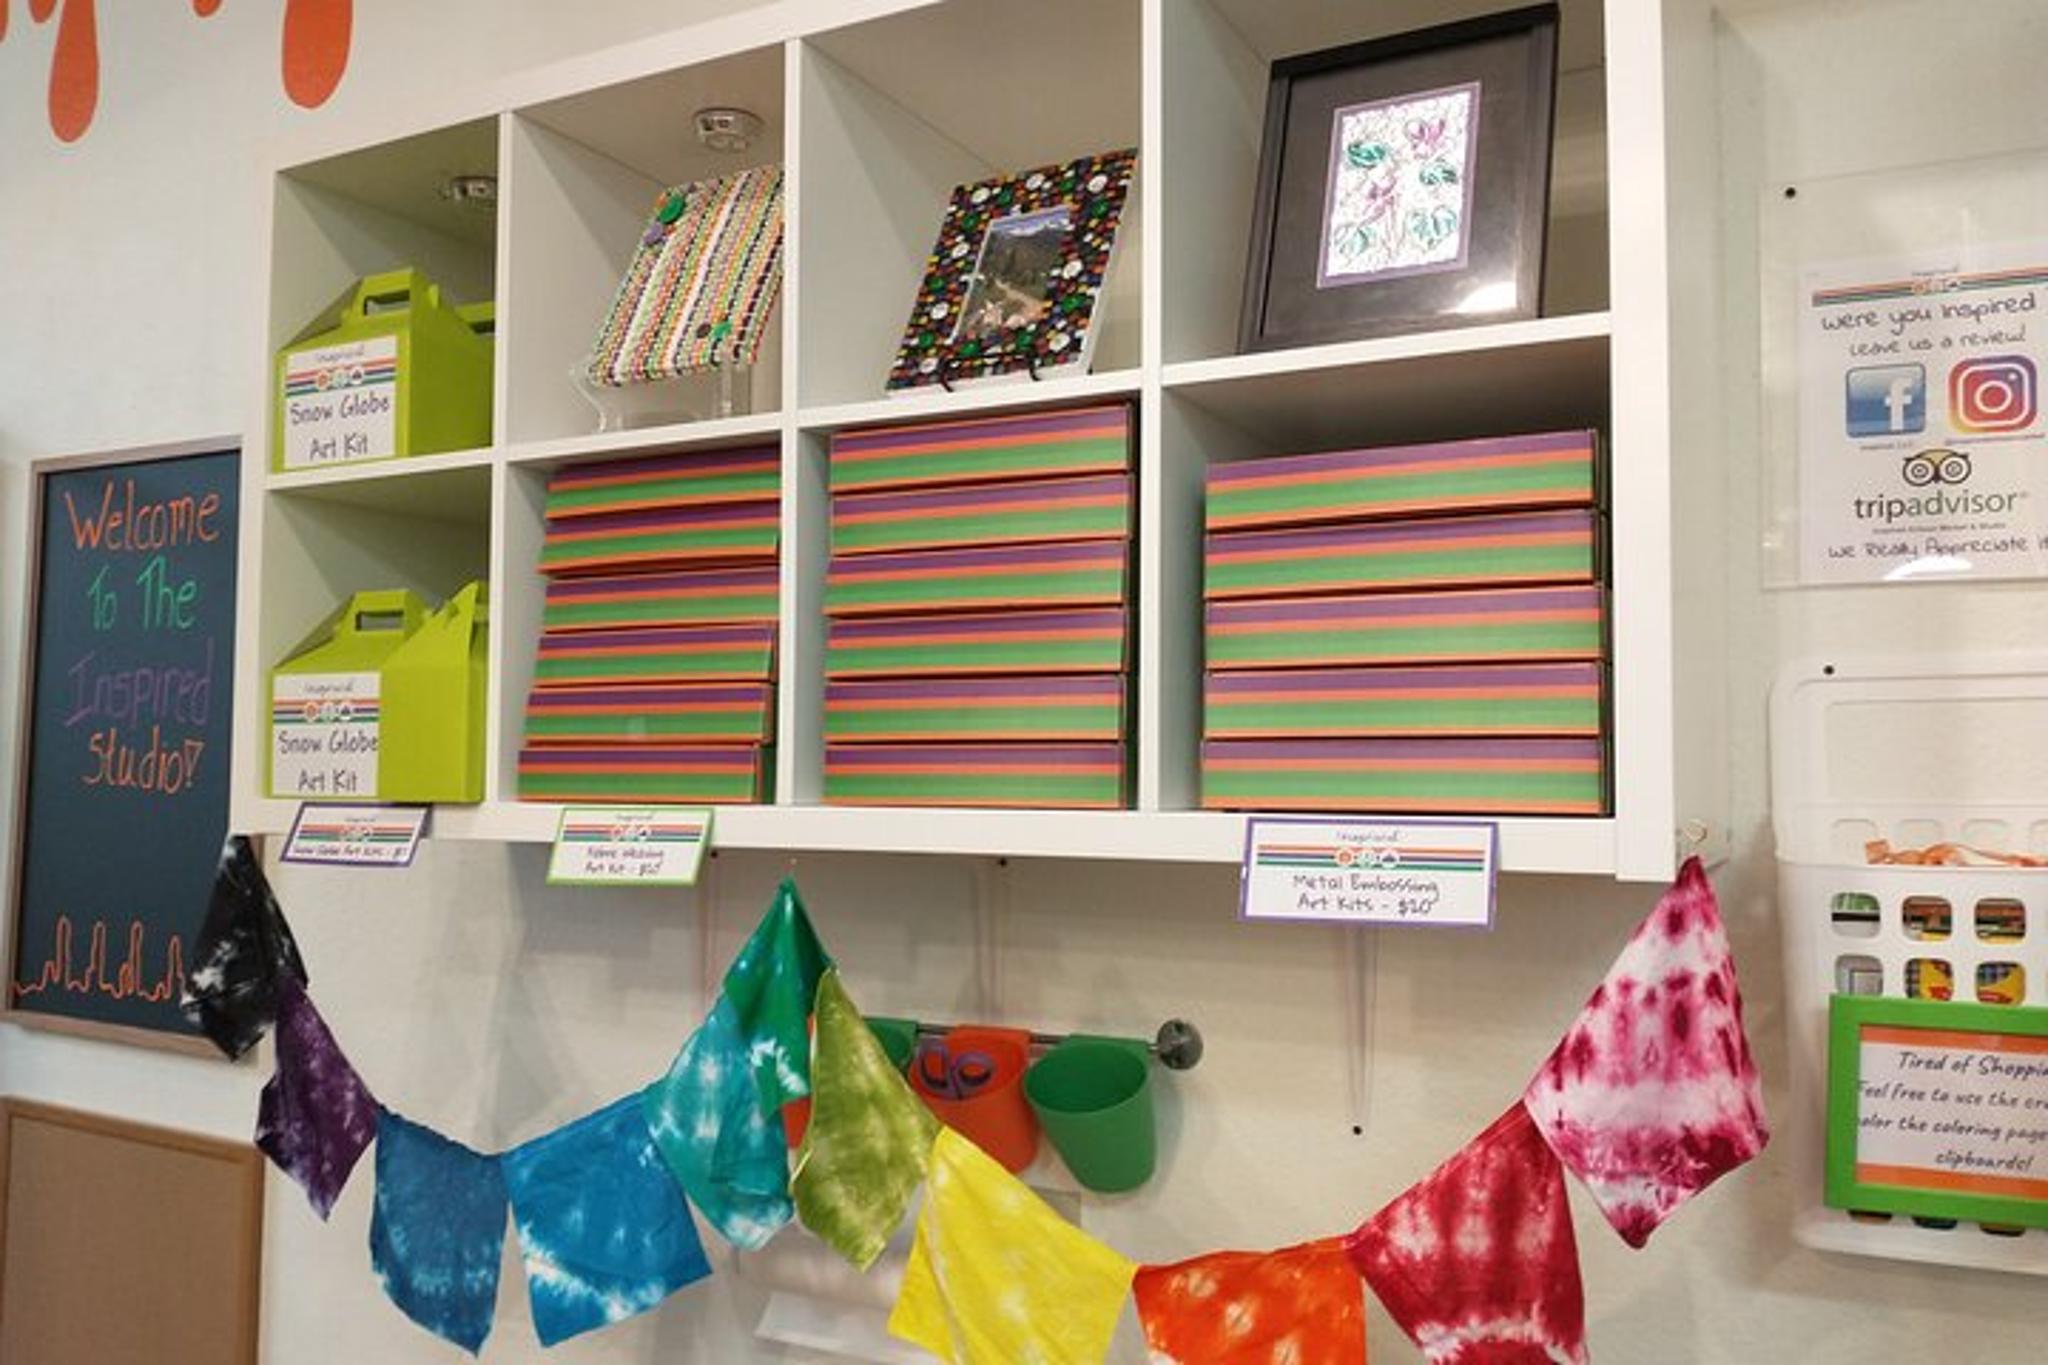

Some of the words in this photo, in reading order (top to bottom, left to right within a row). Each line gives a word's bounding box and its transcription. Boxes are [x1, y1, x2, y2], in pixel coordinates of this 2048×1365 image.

[1888, 308, 1932, 336] you
[1908, 337, 1934, 350] us
[1940, 336, 1953, 348] a
[290, 402, 333, 426] Snow
[340, 390, 391, 419] Globe
[310, 438, 337, 460] Art
[343, 432, 368, 458] Kit
[64, 478, 221, 551] Welcome
[1854, 489, 2018, 524] tripadvisor
[1925, 536, 2029, 557] Appreciate
[136, 554, 198, 630] The
[63, 634, 216, 730] Inspired
[278, 730, 322, 754] Snow
[329, 729, 379, 753] Globe
[298, 769, 325, 792] Art
[332, 769, 358, 793] Kit
[1292, 874, 1343, 890] Metal
[1351, 873, 1440, 902] Embossing
[1296, 893, 1329, 910] Art
[1338, 895, 1374, 912] Kits
[1898, 1051, 1948, 1071] Tired
[1951, 1054, 1975, 1074] of
[1891, 1080, 1925, 1101] free
[1931, 1088, 1950, 1102] to
[1955, 1092, 1981, 1106] use
[1987, 1091, 2019, 1109] the
[1857, 1113, 1893, 1129] olor
[1899, 1116, 1928, 1132] the
[1932, 1119, 2002, 1141] coloring
